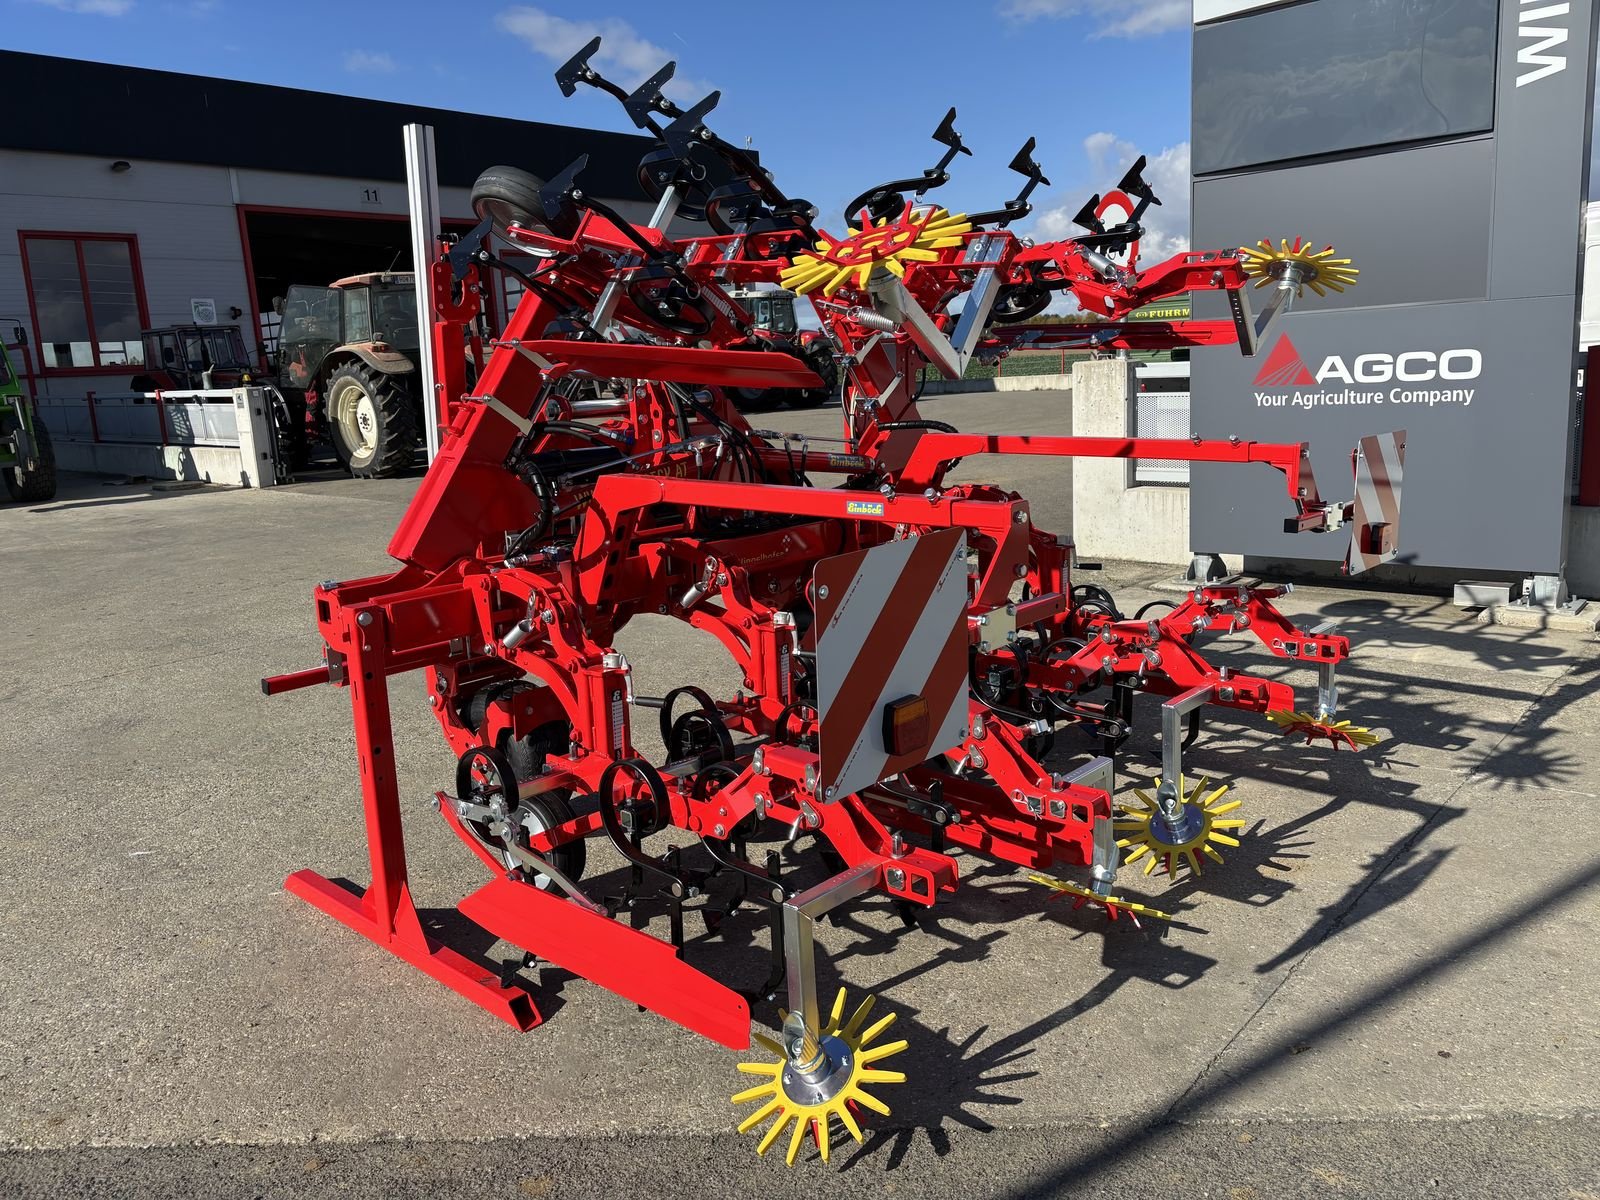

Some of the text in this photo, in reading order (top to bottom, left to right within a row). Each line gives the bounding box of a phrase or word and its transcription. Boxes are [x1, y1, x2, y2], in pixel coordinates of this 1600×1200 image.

[1515, 0, 1570, 89] WI
[363, 188, 378, 202] 11
[1314, 348, 1482, 385] AGCO
[1254, 387, 1475, 410] Your Agriculture Company
